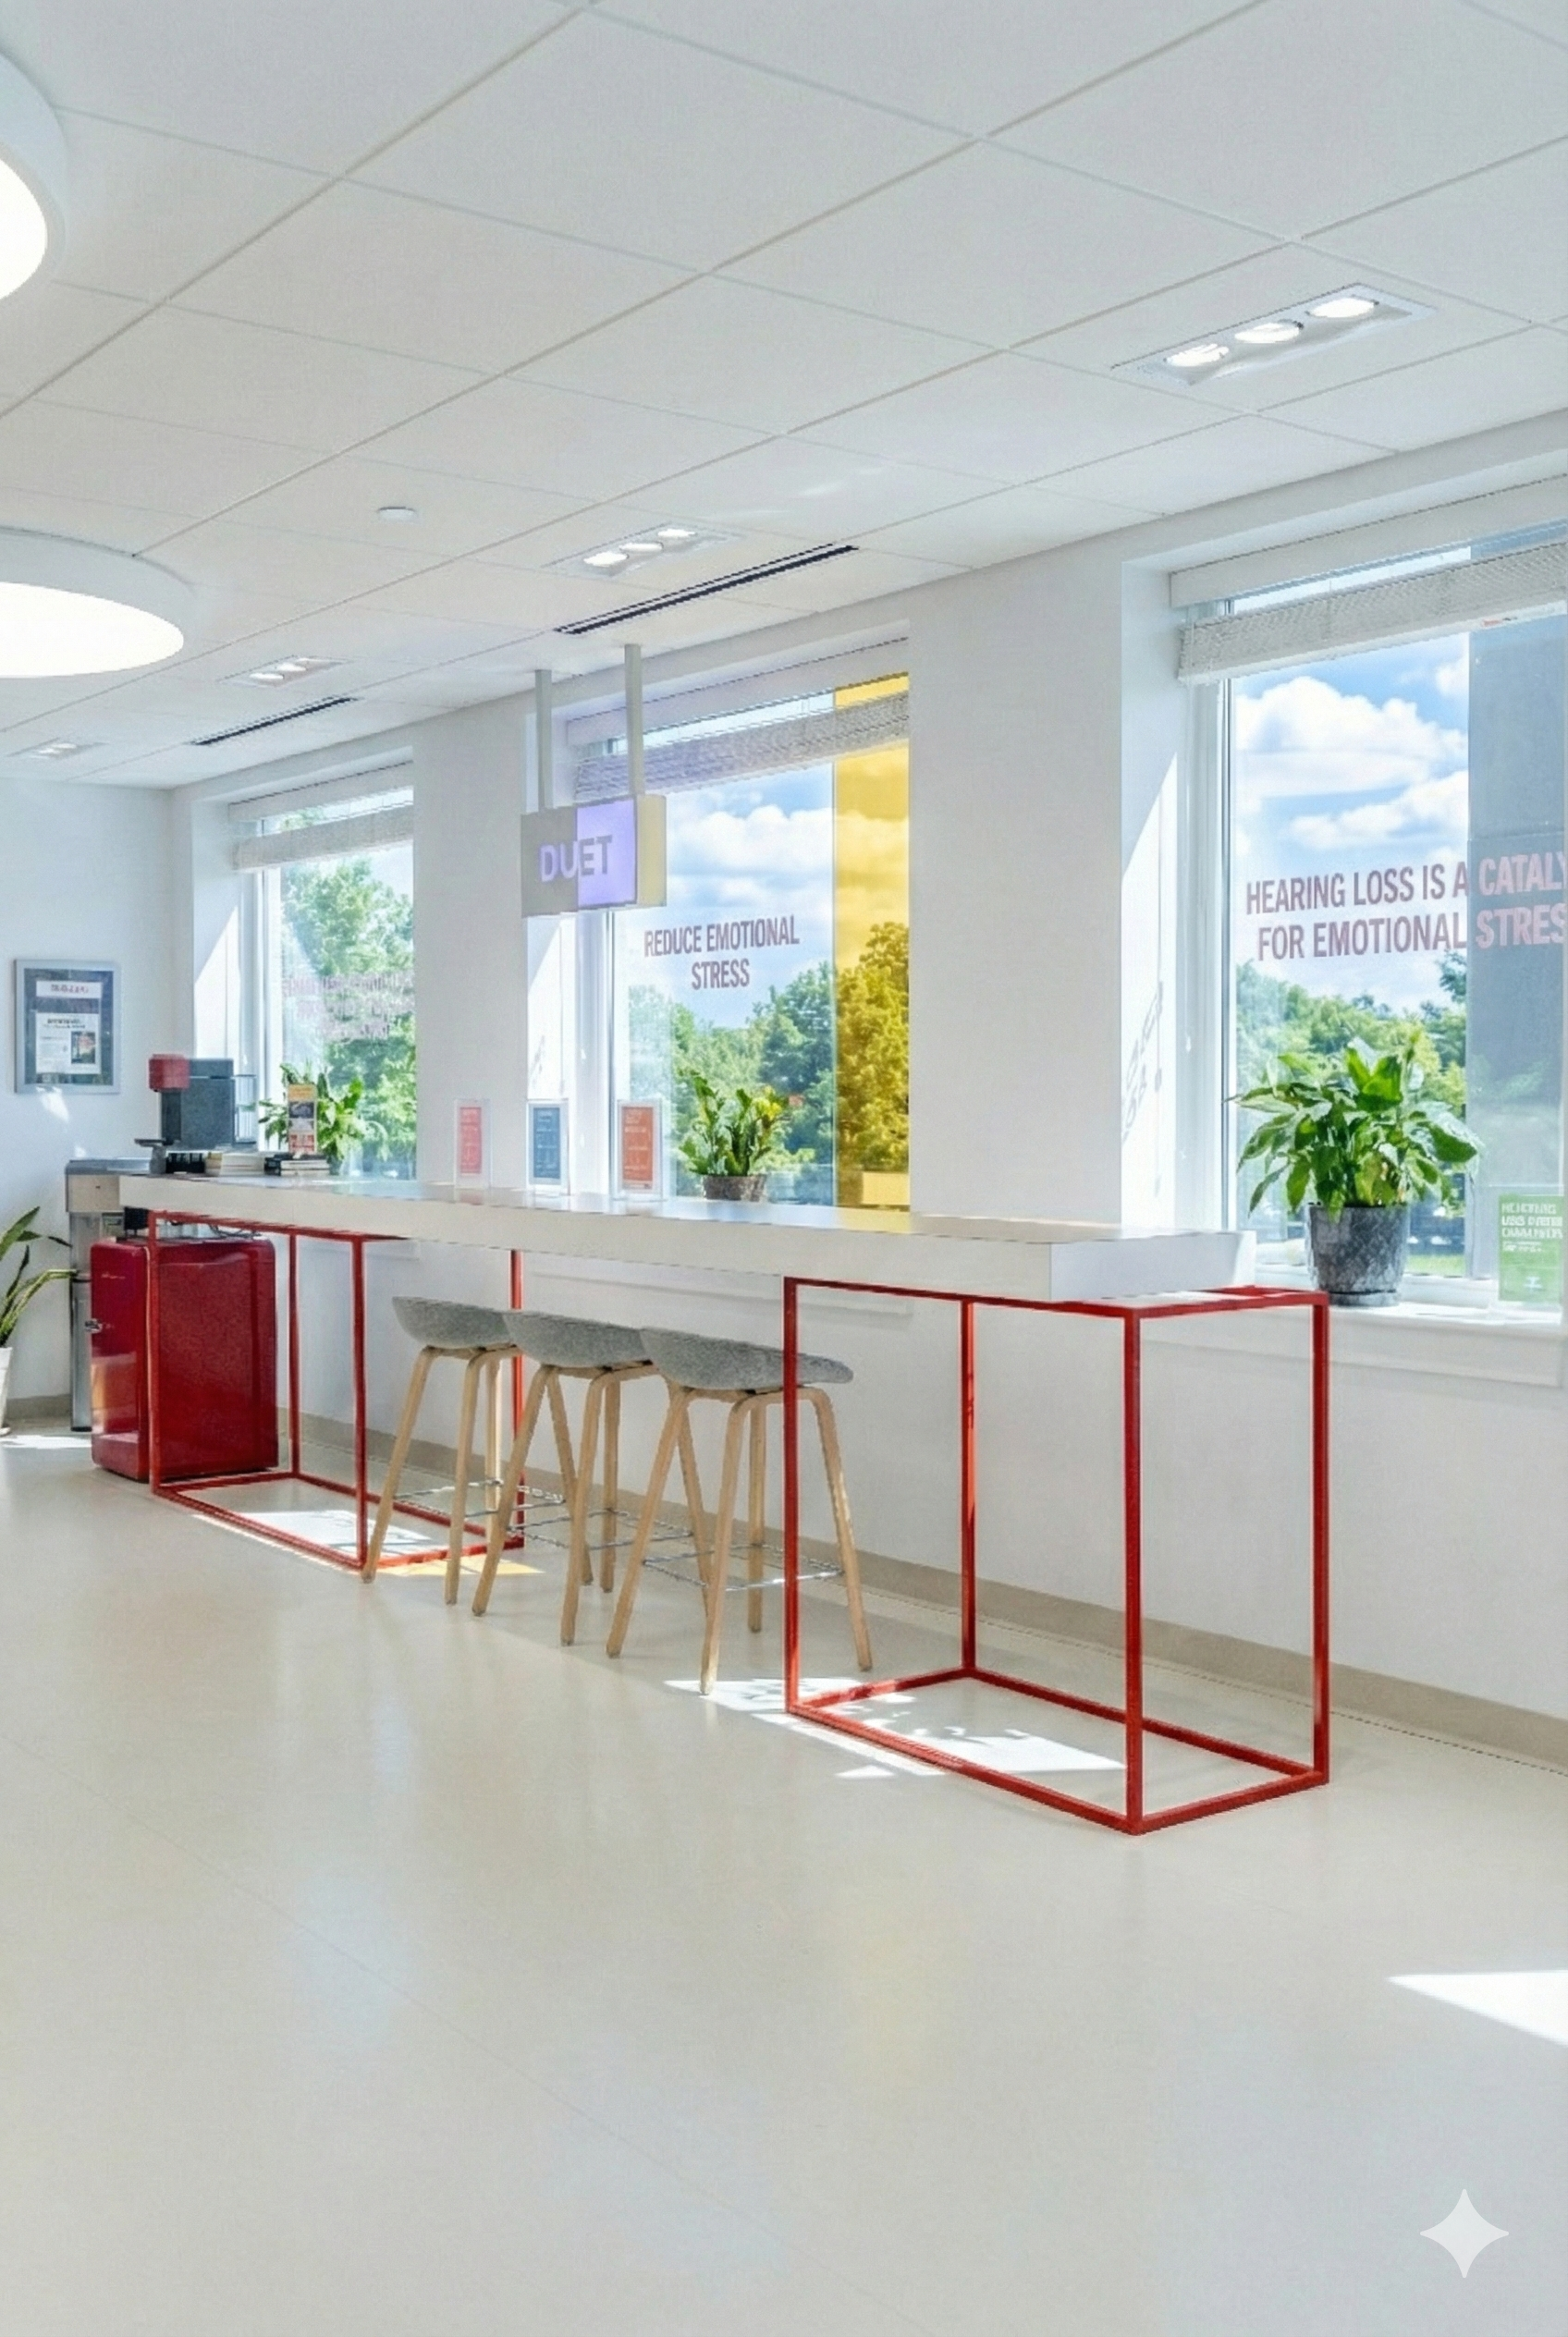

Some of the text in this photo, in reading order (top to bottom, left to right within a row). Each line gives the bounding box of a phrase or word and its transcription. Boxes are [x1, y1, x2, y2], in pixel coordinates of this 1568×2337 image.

[540, 835, 613, 883] DUET
[1246, 873, 1345, 915] HEARING
[1354, 866, 1415, 906] LOSS
[1423, 864, 1446, 900] IS
[1452, 861, 1470, 899] A
[643, 914, 801, 958] REDUCE EMOTIONAL
[1258, 902, 1568, 961] FOR EMOTIONAL STRES
[691, 958, 750, 990] STRESS
